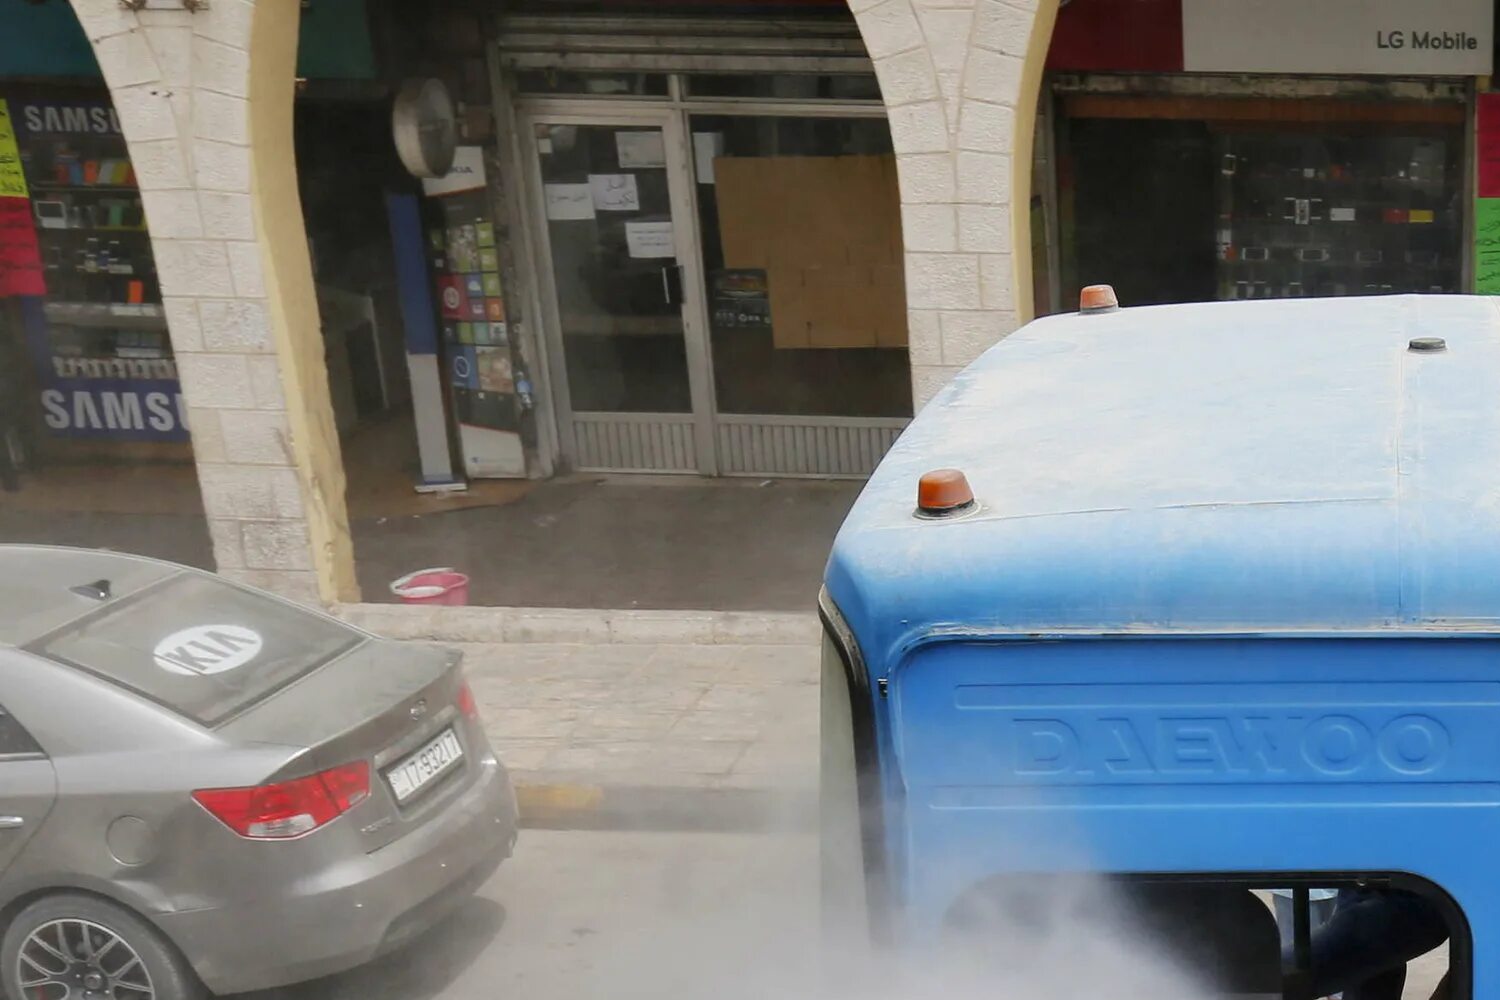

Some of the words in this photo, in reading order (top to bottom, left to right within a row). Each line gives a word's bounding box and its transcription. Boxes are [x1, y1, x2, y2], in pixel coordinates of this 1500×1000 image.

[1376, 30, 1404, 49] LG
[1411, 30, 1478, 50] Mobile
[164, 630, 257, 671] KIA
[1010, 713, 1453, 776] DAEWOO
